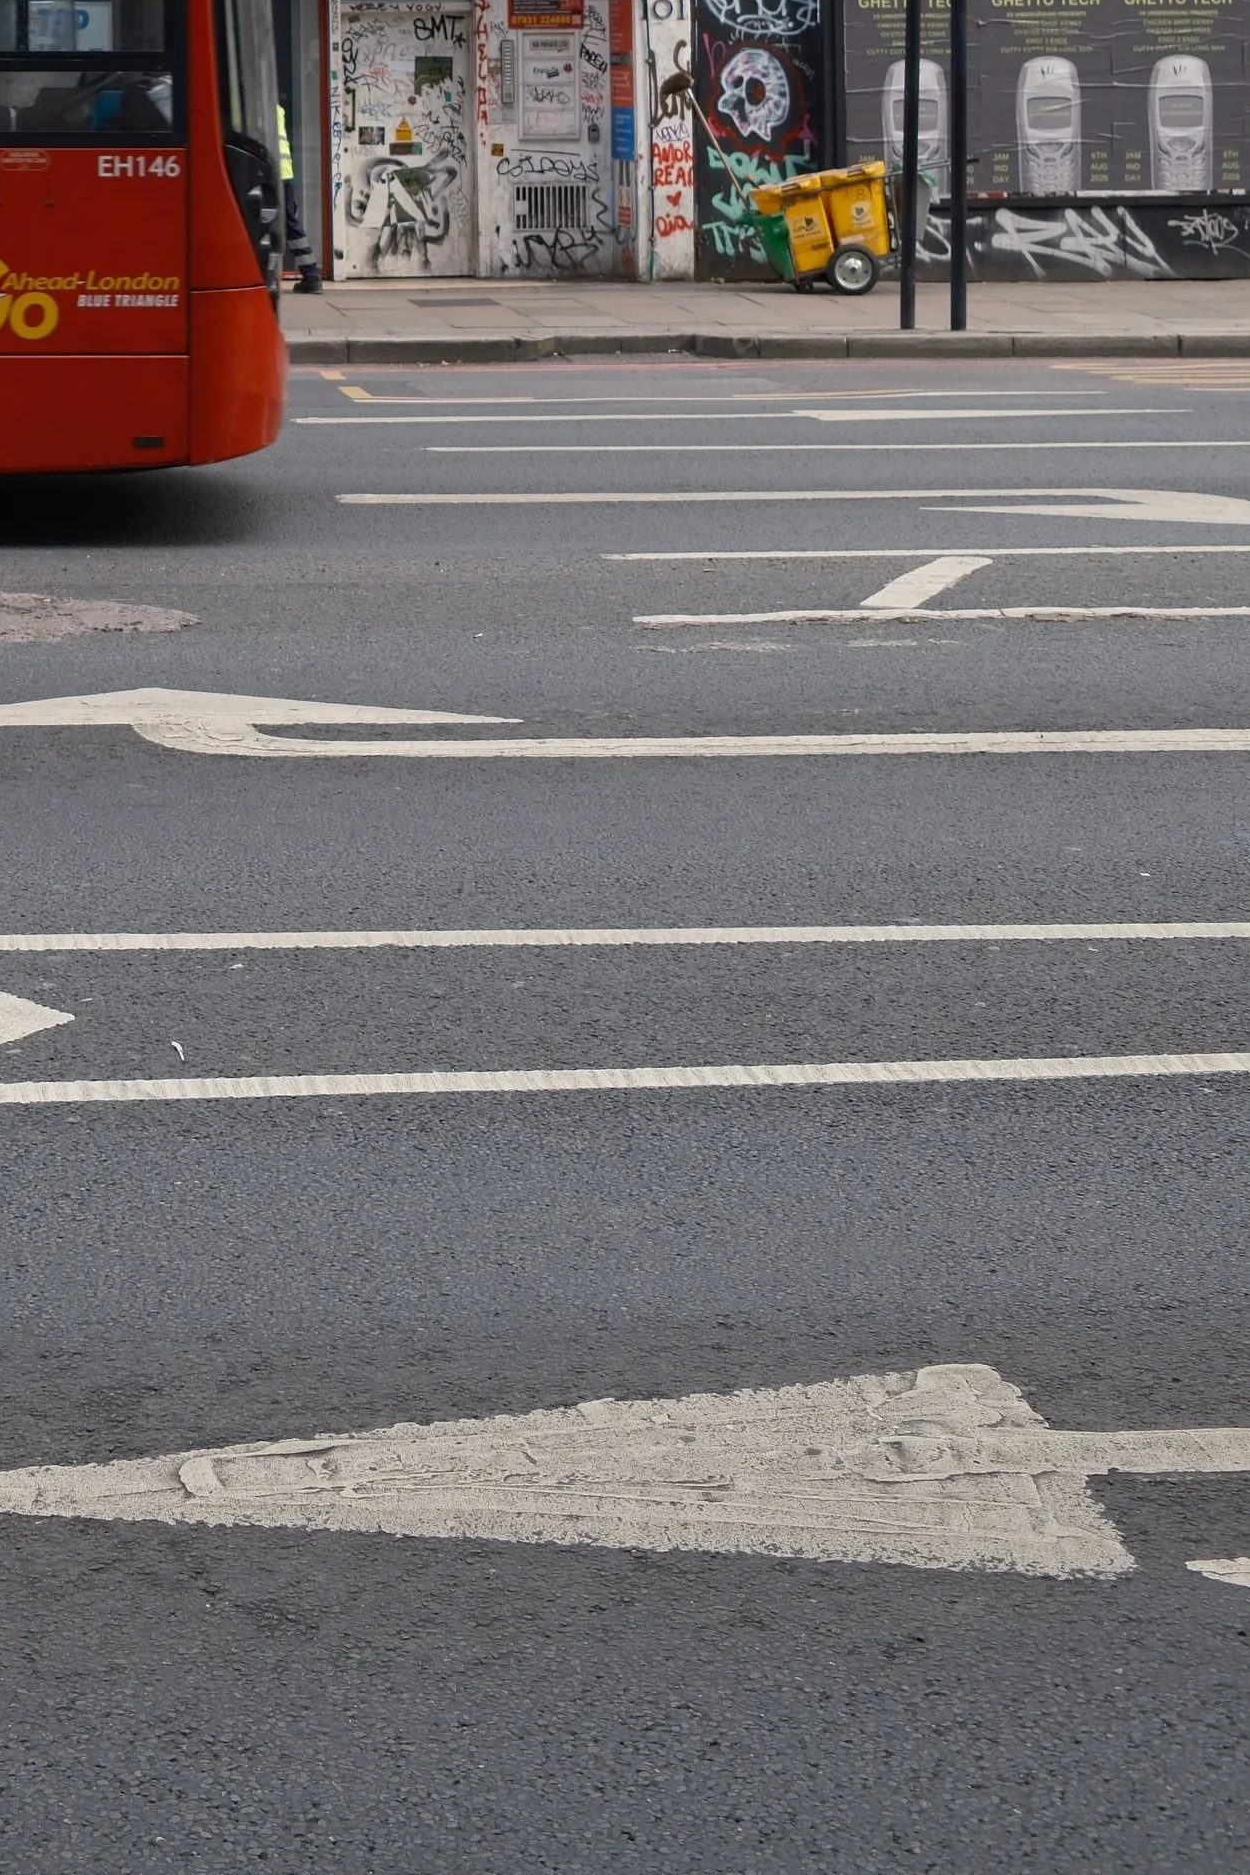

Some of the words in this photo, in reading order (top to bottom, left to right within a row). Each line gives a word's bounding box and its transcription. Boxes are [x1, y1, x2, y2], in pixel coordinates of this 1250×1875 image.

[992, 153, 1010, 161] JAM
[1124, 151, 1141, 159] JAM
[97, 155, 181, 177] EH146
[992, 165, 1010, 173] IND
[1124, 163, 1141, 171] IND
[992, 176, 1010, 184] DAY
[1124, 174, 1141, 182] DAY
[2, 270, 180, 291] Ahead-London
[77, 294, 110, 307] BLUE
[114, 294, 179, 307] TRIANGLE
